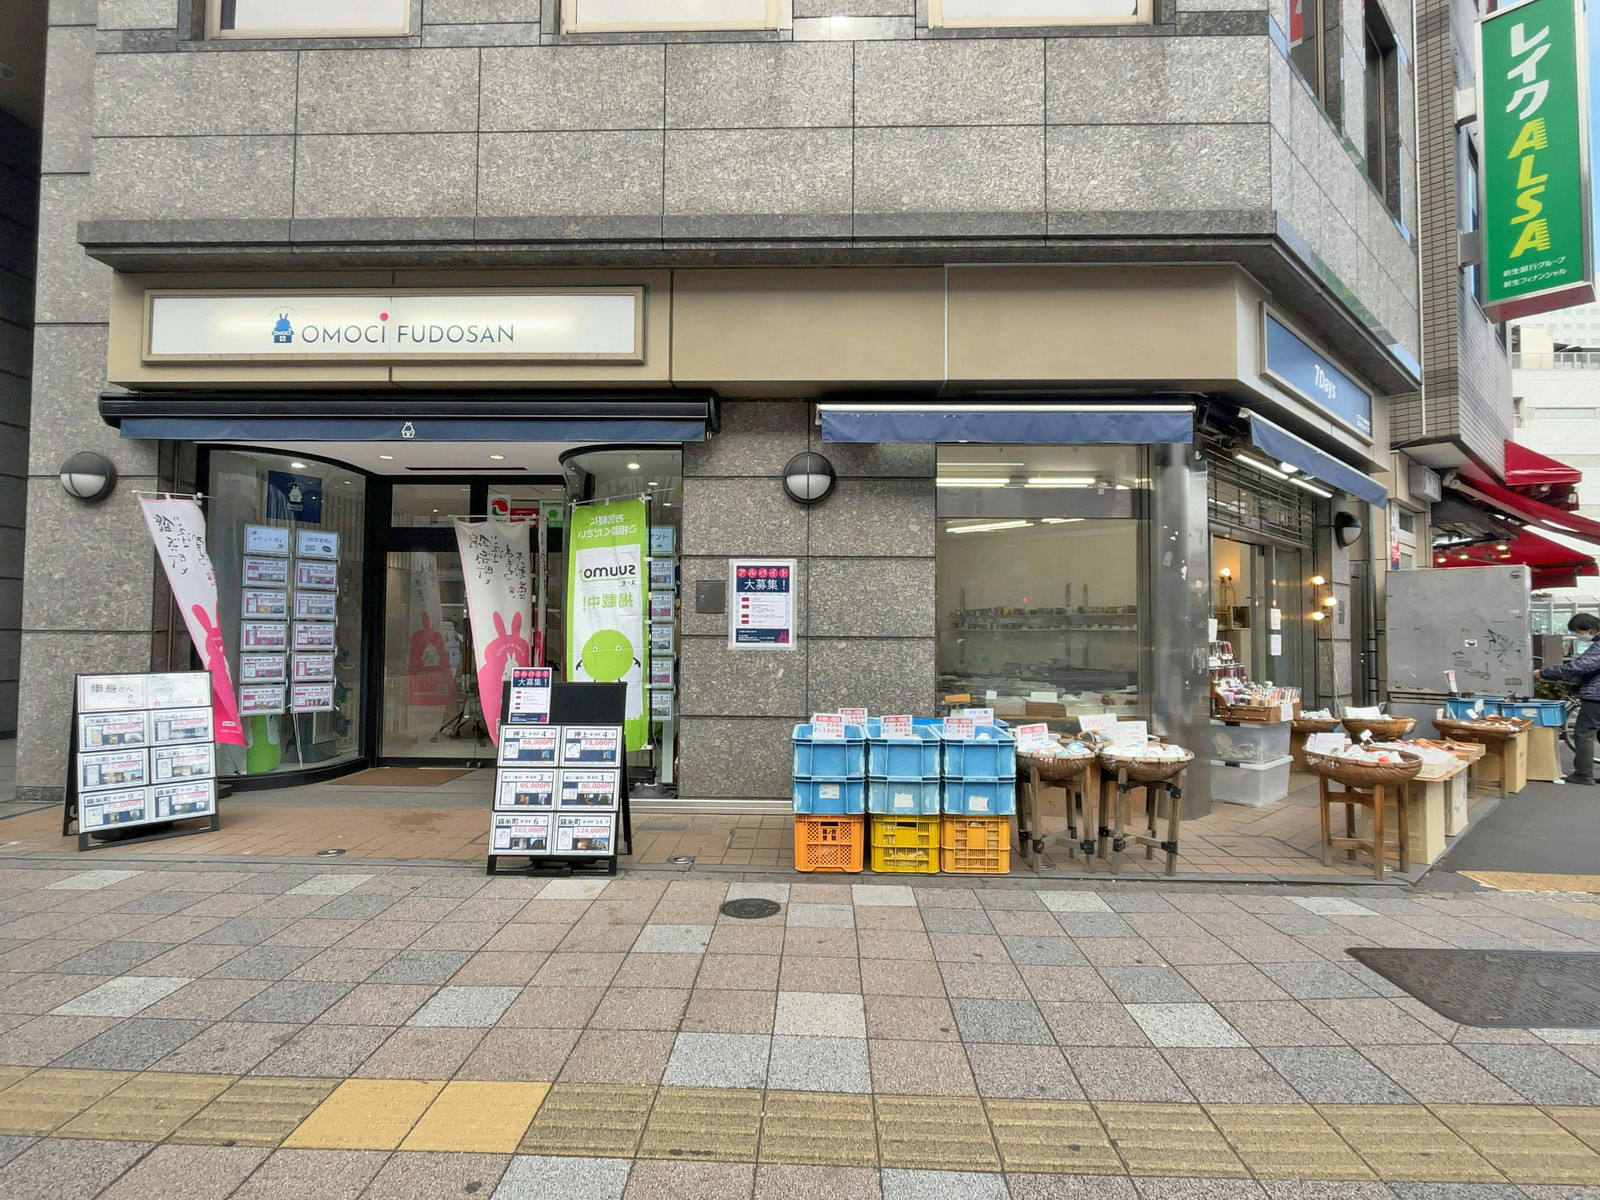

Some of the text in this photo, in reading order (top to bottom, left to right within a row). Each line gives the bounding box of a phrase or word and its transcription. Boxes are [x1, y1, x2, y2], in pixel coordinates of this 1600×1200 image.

[1506, 23, 1551, 120] レイク
[1507, 117, 1551, 258] ALSA
[1503, 256, 1567, 277] 新生銀行グループ
[1503, 268, 1567, 288] 新生フィナンシャル
[397, 324, 514, 343] FUDOSAN
[737, 568, 789, 578] アルバイト
